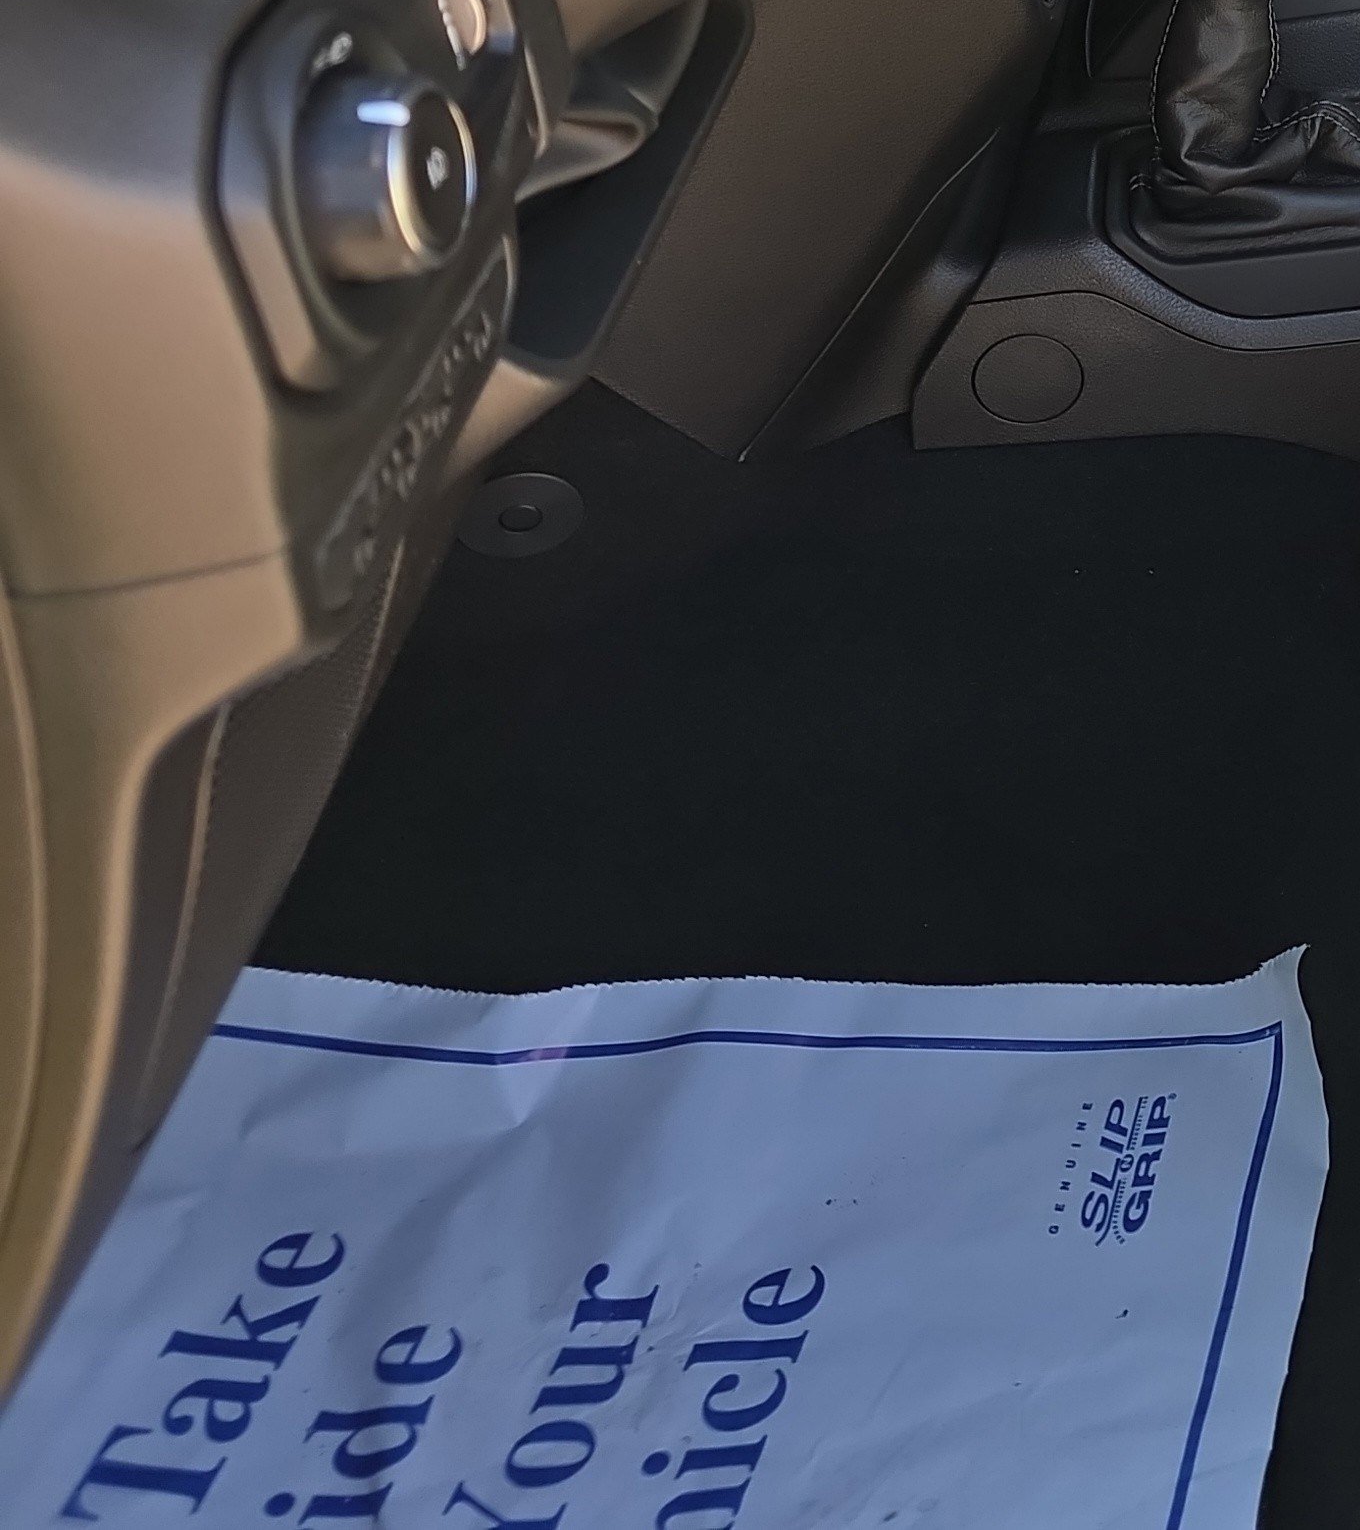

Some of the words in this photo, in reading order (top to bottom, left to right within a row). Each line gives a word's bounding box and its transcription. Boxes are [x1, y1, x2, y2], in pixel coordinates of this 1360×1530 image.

[1048, 1102, 1093, 1235] GENUINE
[1080, 1098, 1129, 1233] SLIP
[1122, 1095, 1171, 1233] GRIP
[59, 1231, 346, 1521] Take
[261, 1325, 462, 1530] ide
